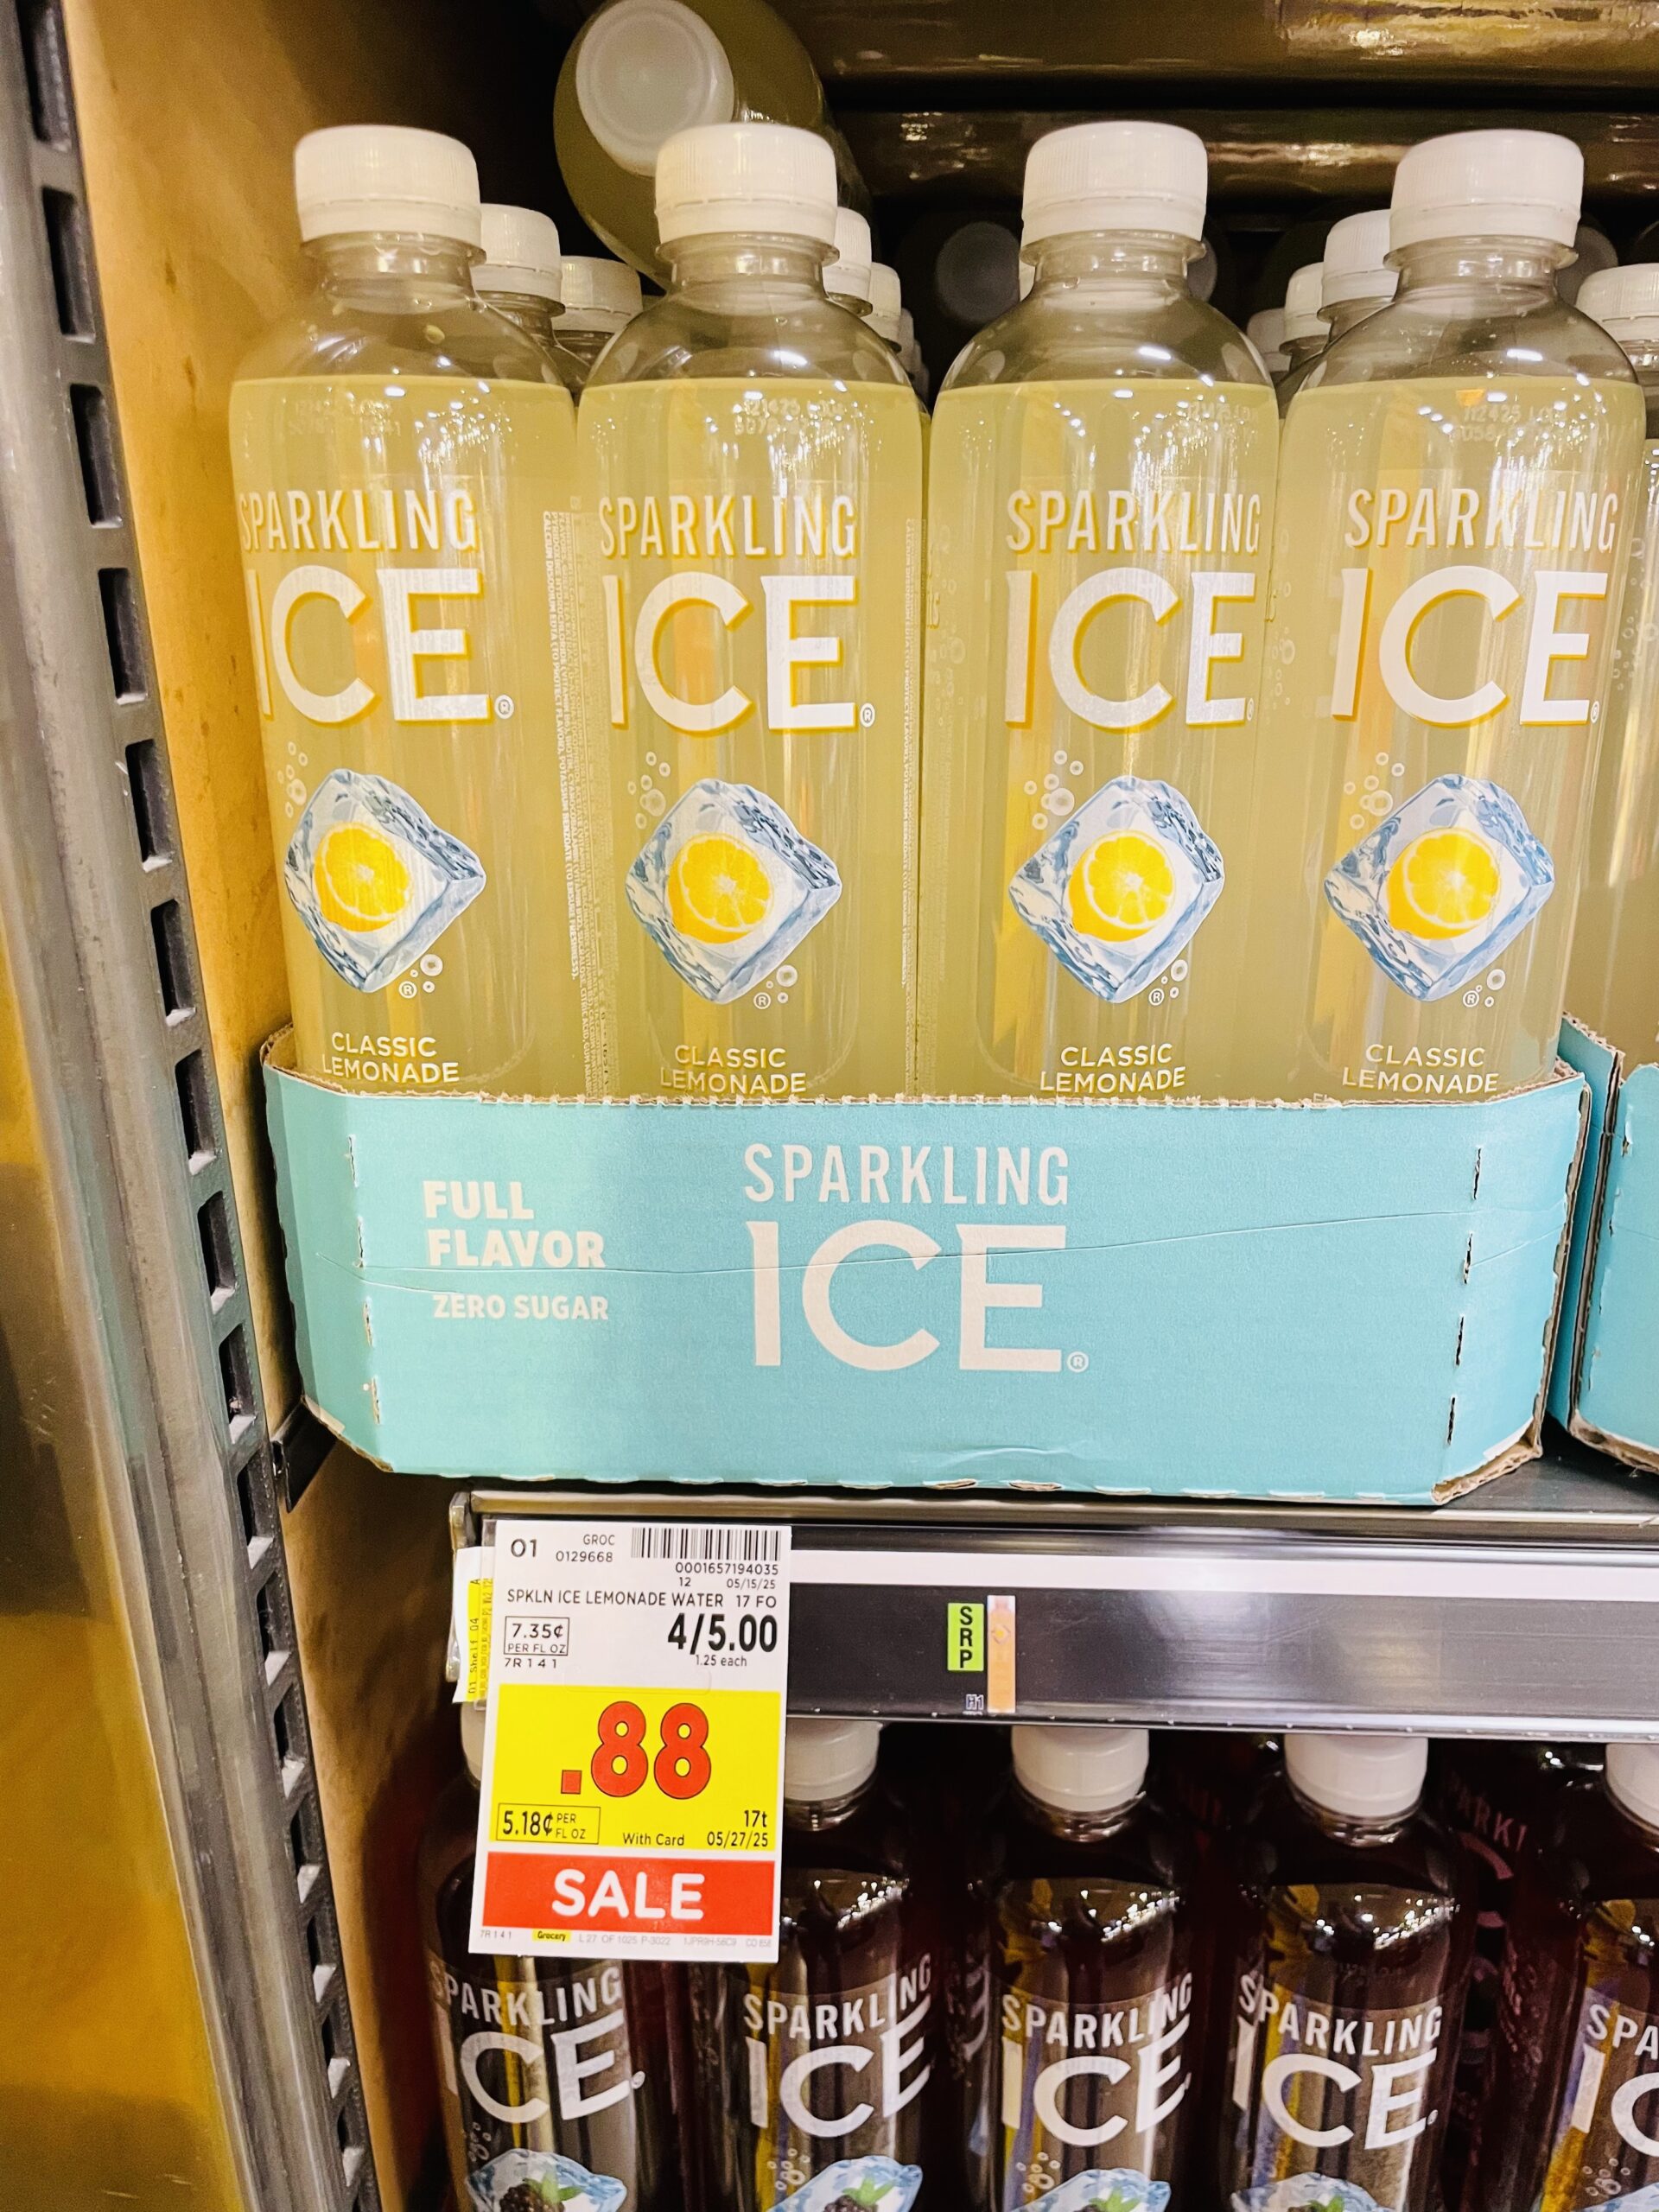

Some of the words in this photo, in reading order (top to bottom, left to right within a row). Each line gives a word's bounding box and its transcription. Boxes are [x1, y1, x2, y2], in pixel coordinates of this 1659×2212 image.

[238, 489, 480, 551] SPARKLING
[599, 494, 858, 558] SPARKLING
[1005, 489, 1261, 553] SPARKLING
[1344, 487, 1619, 553] SPARKLING
[332, 1032, 437, 1058] CLASSIC
[674, 1045, 787, 1069] CLASSIC
[1060, 1043, 1173, 1068] CLASSIC
[1365, 1044, 1485, 1068] CLASSIC
[322, 1054, 460, 1084] LEMONADE
[659, 1066, 807, 1095] LEMONADE
[1039, 1065, 1186, 1094] LEMONADE
[1342, 1066, 1499, 1095] LEMONADE
[743, 1143, 1069, 1206] SPARKLING
[423, 1180, 534, 1219] FULL
[427, 1229, 607, 1268] FLAVOR
[432, 1294, 506, 1319] ZERO
[514, 1294, 609, 1320] SUGAR
[746, 1219, 1067, 1372] ICE
[582, 1533, 615, 1547] GROC
[555, 1550, 614, 1564] 0129668
[675, 1561, 779, 1576] 0001657194035
[678, 1576, 692, 1587] 12
[726, 1577, 777, 1591] 05/15/25
[506, 1589, 554, 1605] SPKLN
[557, 1590, 582, 1605] ICE
[585, 1591, 667, 1607] LEMONADE
[671, 1592, 724, 1608] WATER
[736, 1594, 750, 1608] 17
[755, 1595, 779, 1609] FO
[469, 1618, 480, 1631] 04
[511, 1622, 565, 1640] 7.35¢
[667, 1611, 779, 1656] 4/5.00
[469, 1640, 479, 1673] Shelf
[507, 1643, 531, 1654] PER
[532, 1643, 547, 1654] FL
[550, 1643, 567, 1655] OZ
[695, 1654, 717, 1667] 1.25
[720, 1655, 748, 1668] each
[502, 1809, 554, 1838] 5.18¢
[556, 1813, 577, 1824] PER
[743, 1808, 768, 1828] 17t
[556, 1827, 568, 1839] FL
[569, 1828, 587, 1840] OZ
[622, 1832, 652, 1847] With
[655, 1833, 685, 1847] Card
[707, 1831, 769, 1848] 05/27/25
[551, 1867, 706, 1921] SALE
[537, 1930, 567, 1942] Grocery
[743, 1953, 931, 2040] SPARKLING
[1002, 1972, 1192, 2049] SPARKLING
[1238, 1974, 1443, 2056] SPARKLING
[745, 1993, 931, 2139] ICE
